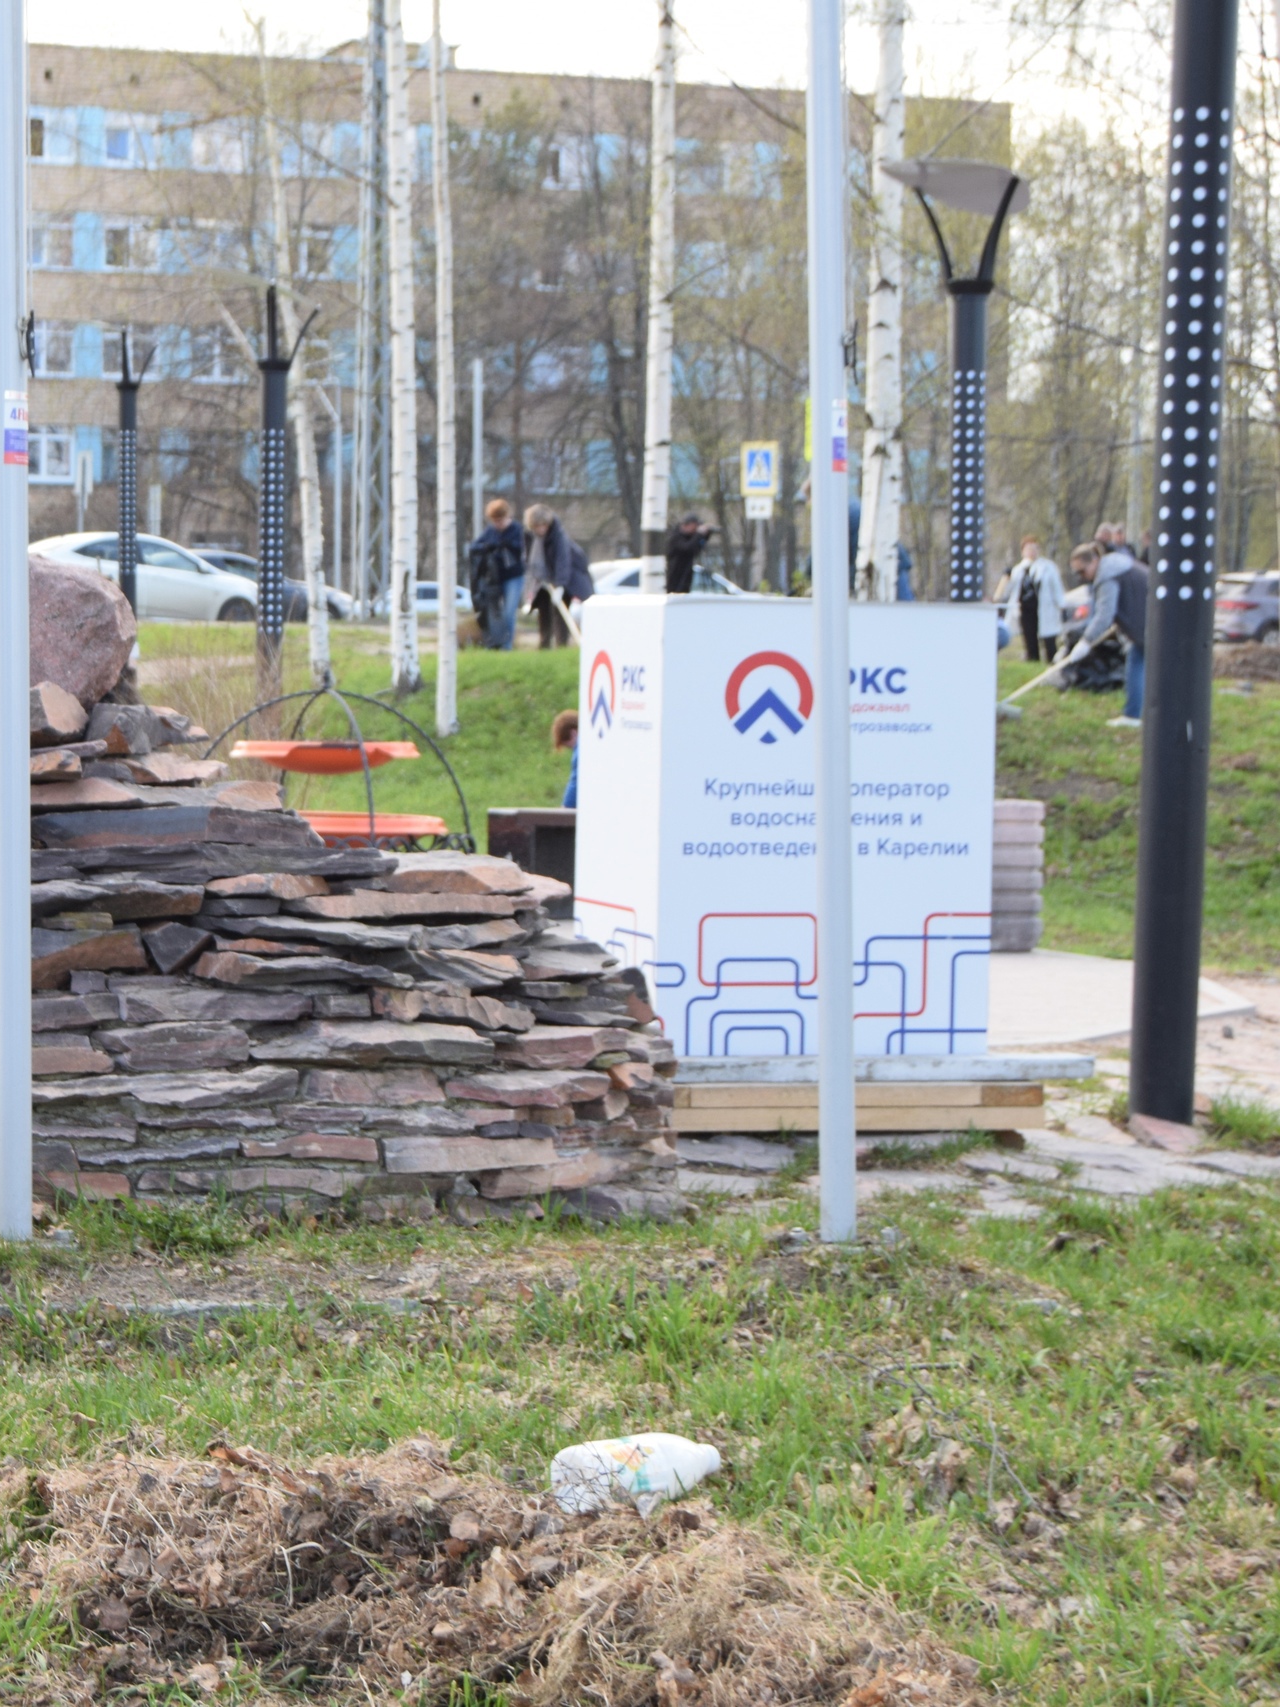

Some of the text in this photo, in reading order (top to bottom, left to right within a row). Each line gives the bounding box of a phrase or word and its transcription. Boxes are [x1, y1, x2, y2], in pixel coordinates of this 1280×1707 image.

[621, 665, 646, 693] РКС
[849, 703, 911, 714] доканал
[850, 722, 934, 735] трозаводск
[704, 778, 950, 801] Крупнейш оператор
[730, 811, 923, 828] водоснаения и
[682, 838, 969, 861] водоотведе в Карелии
